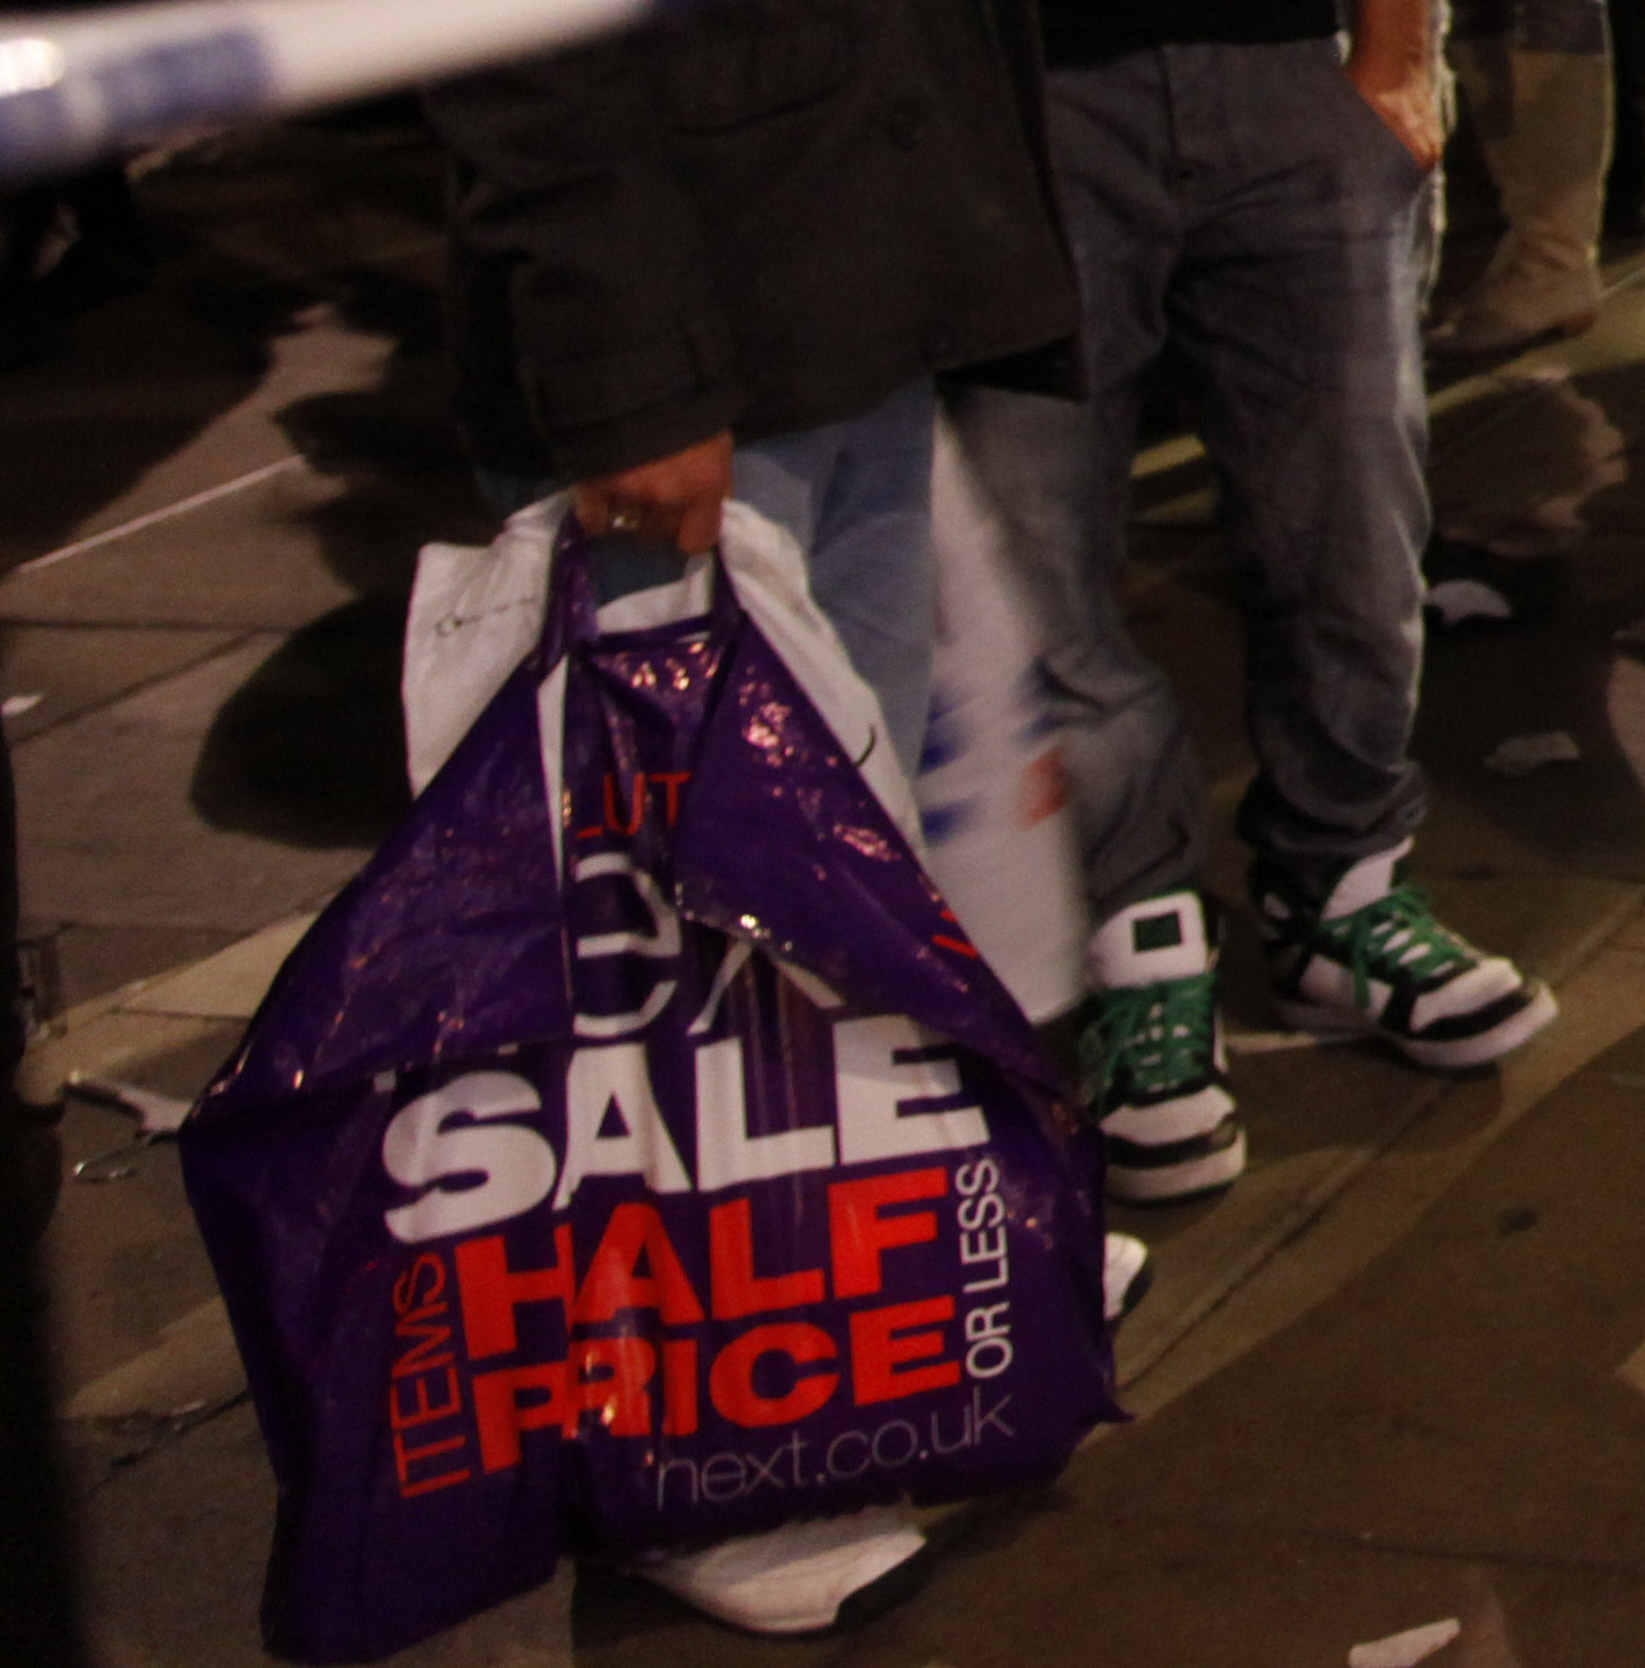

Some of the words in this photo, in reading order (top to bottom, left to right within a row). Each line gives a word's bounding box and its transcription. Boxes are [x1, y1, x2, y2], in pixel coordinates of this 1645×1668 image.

[382, 1014, 992, 1244] SALE
[455, 1166, 949, 1361] HALF
[955, 1158, 1010, 1295] LESS
[390, 1251, 472, 1500] ITEMS
[472, 1295, 962, 1475] PRICE
[965, 1301, 1014, 1380] OR
[656, 1385, 1014, 1512] next.co.uk
